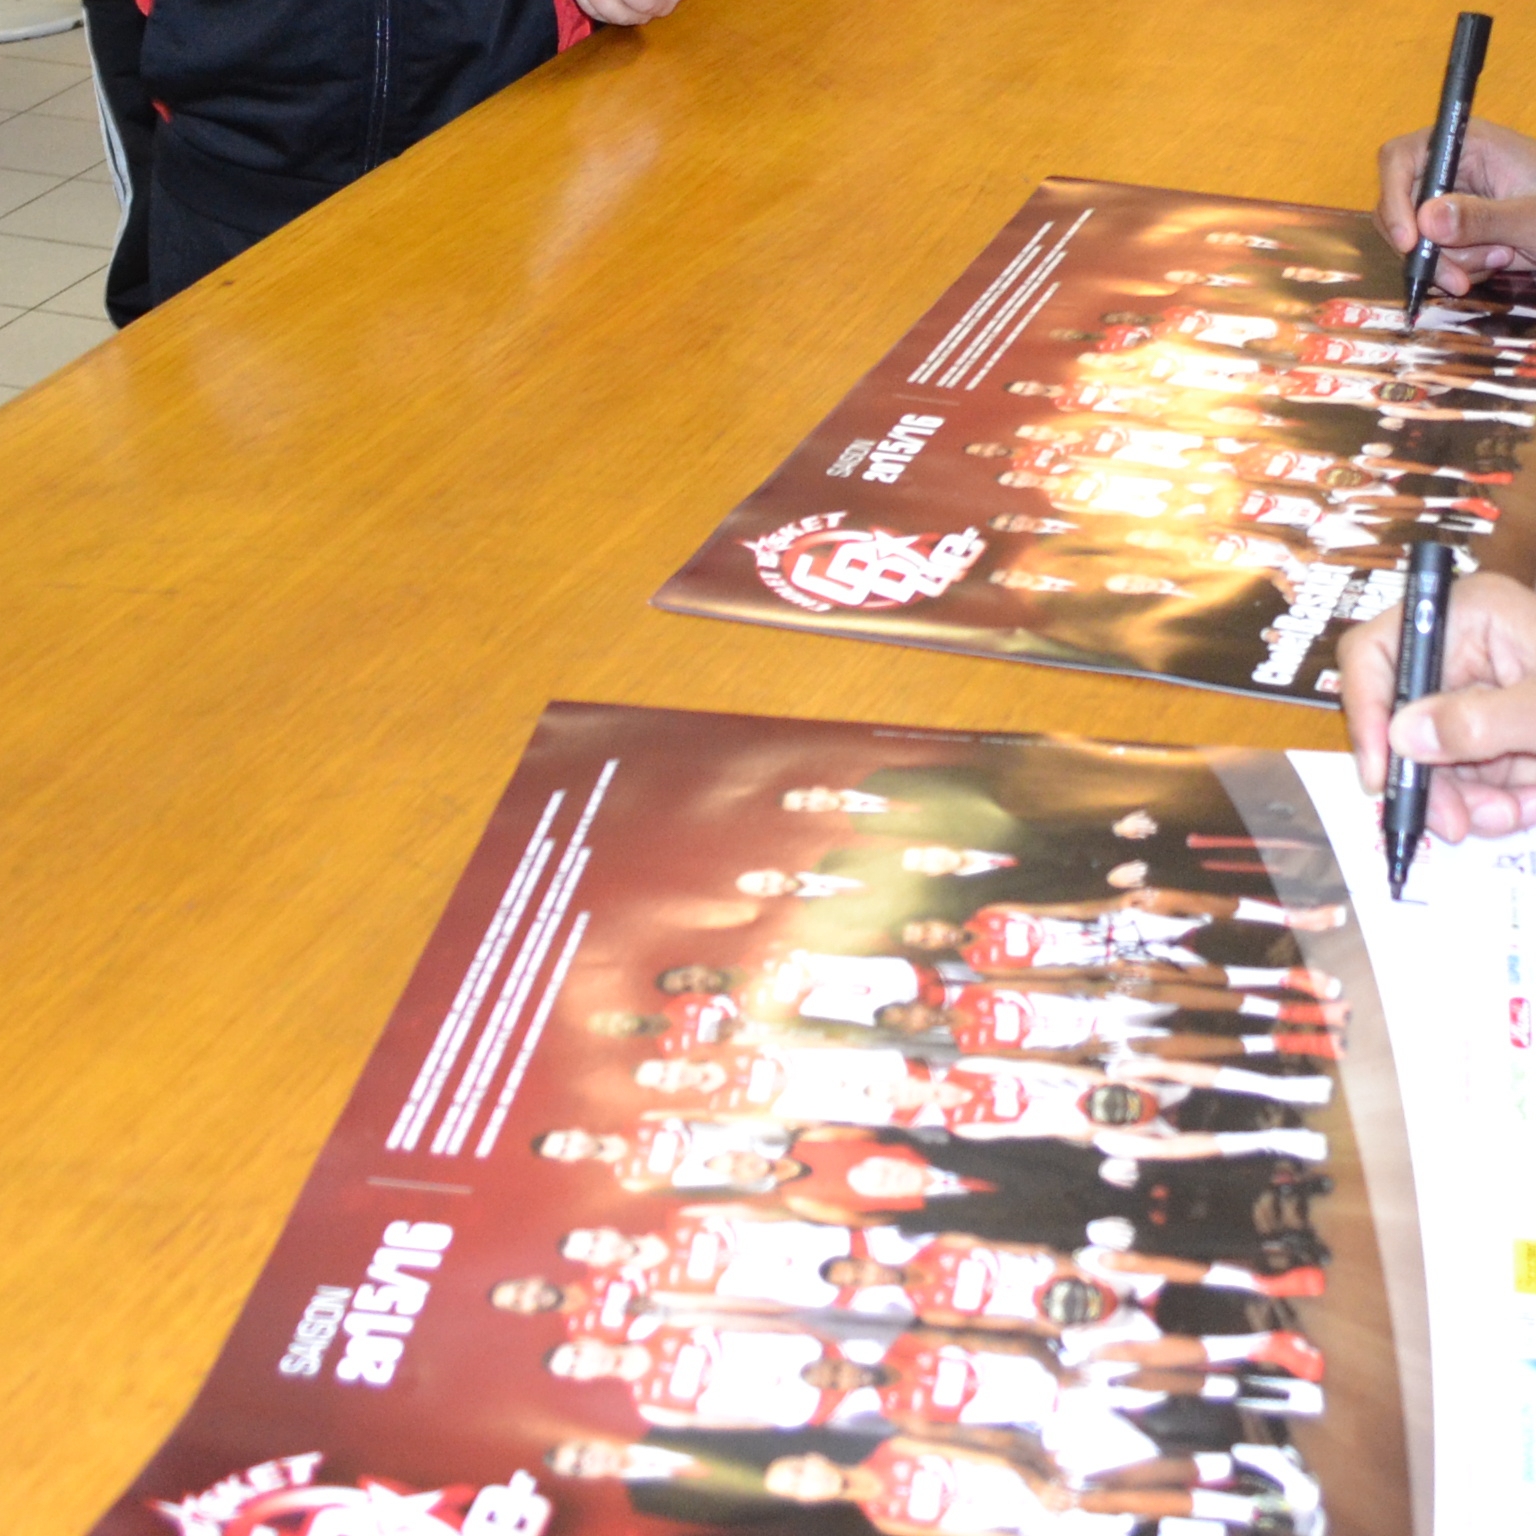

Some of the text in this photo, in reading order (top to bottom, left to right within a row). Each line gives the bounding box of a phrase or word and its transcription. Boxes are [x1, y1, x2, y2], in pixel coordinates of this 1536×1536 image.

[826, 438, 877, 478] SAISON
[861, 413, 945, 485] 2015/16
[279, 1285, 353, 1376] SAISON
[336, 1220, 455, 1385] 2015/16
